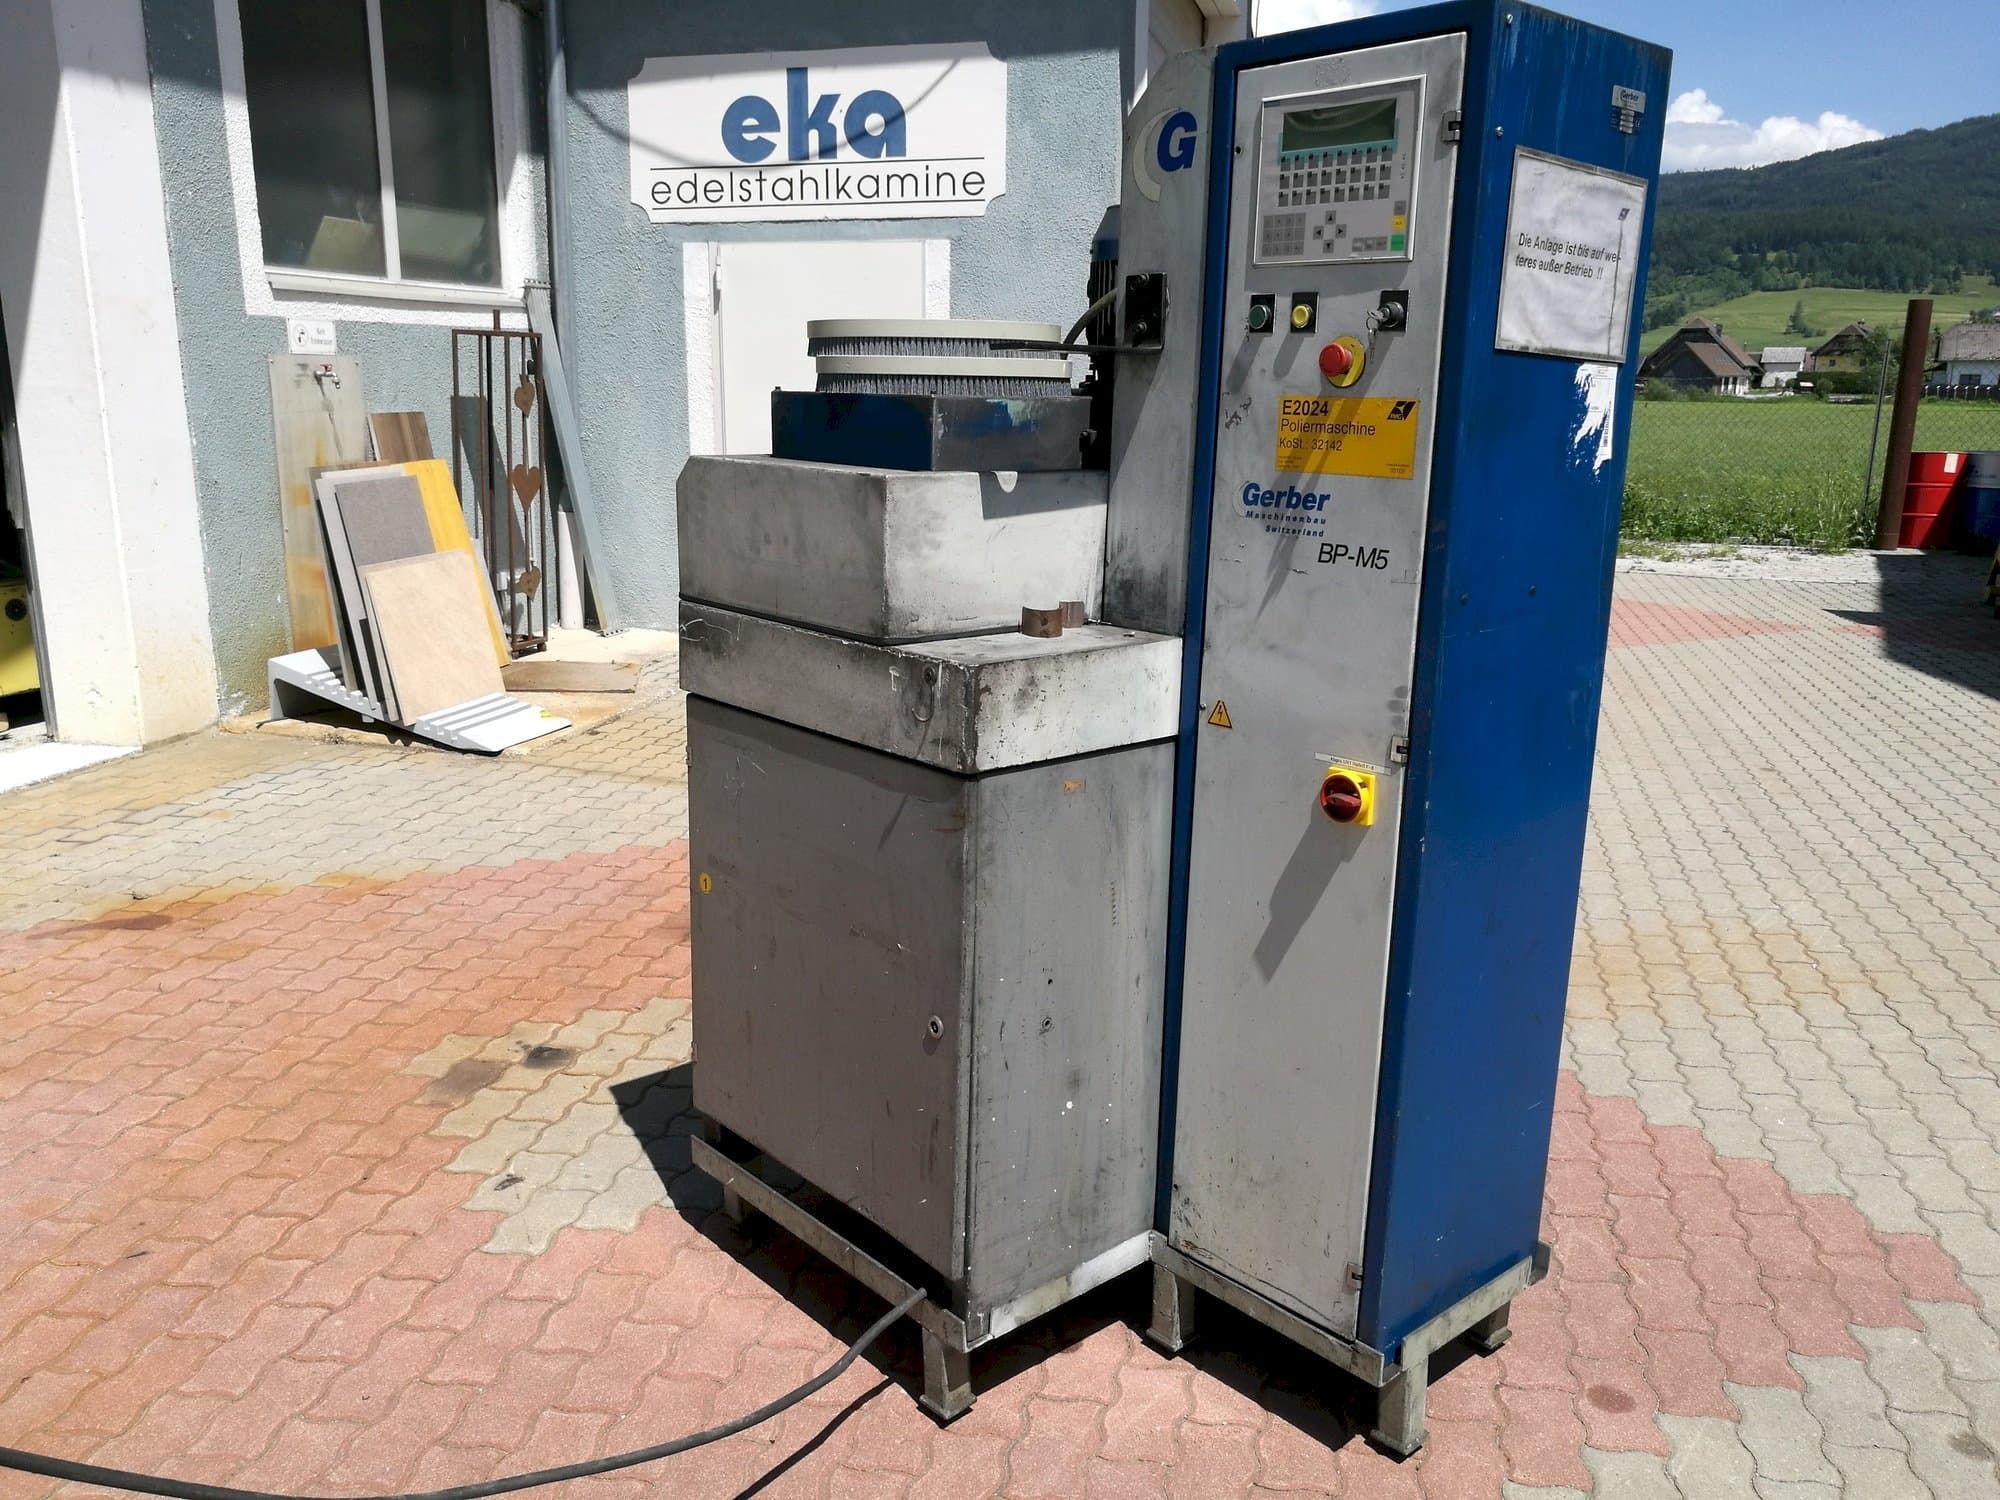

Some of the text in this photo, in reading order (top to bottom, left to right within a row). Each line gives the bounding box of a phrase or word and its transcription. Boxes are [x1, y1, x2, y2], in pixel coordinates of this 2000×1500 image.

[721, 66, 907, 164] eka
[1157, 111, 1198, 172] G
[651, 165, 985, 205] edelstahlkamine
[1518, 233, 1532, 247] Die
[1533, 236, 1564, 256] Anlage
[1565, 241, 1577, 256] ist
[1577, 244, 1590, 258] bis
[1590, 248, 1605, 261] auf
[1515, 253, 1604, 280] teres außer Betrieb !!
[1282, 400, 1329, 417] E2024
[1280, 418, 1377, 437] Poliermaschine
[1311, 439, 1343, 452] 32142
[1242, 483, 1331, 511] Gerber
[1245, 511, 1326, 525] Maschinenbau
[1265, 525, 1324, 537] Switzerland
[1317, 542, 1390, 570] BP-M5
